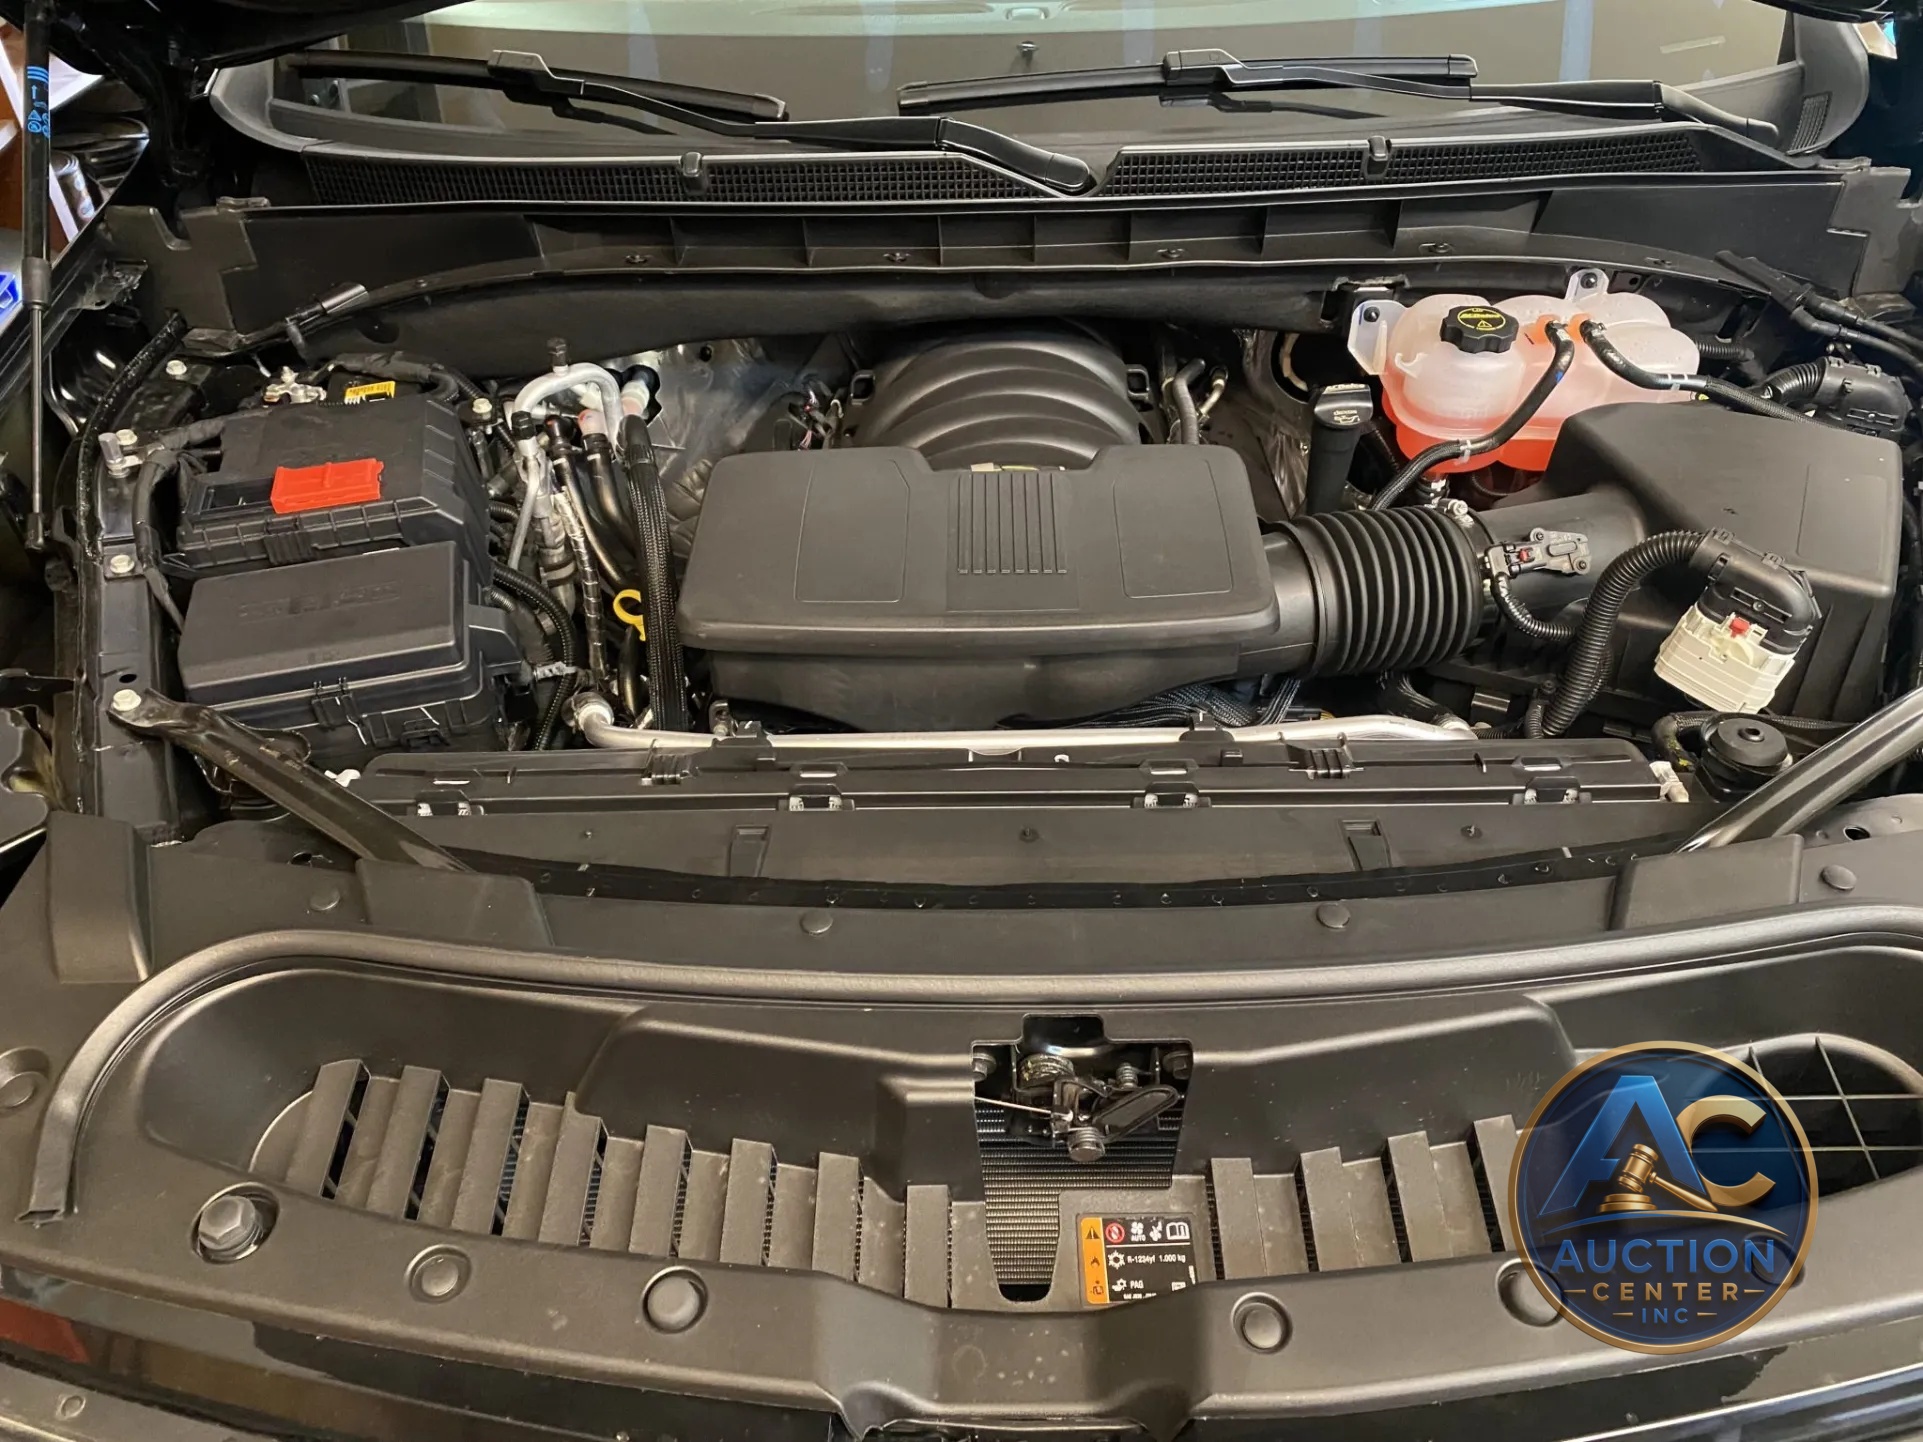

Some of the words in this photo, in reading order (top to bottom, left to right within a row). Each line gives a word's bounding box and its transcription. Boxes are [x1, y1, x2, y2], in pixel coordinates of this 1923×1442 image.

[1127, 1255, 1156, 1265] R-1234yf
[1177, 1254, 1186, 1263] kg
[1130, 1280, 1144, 1289] PAG
